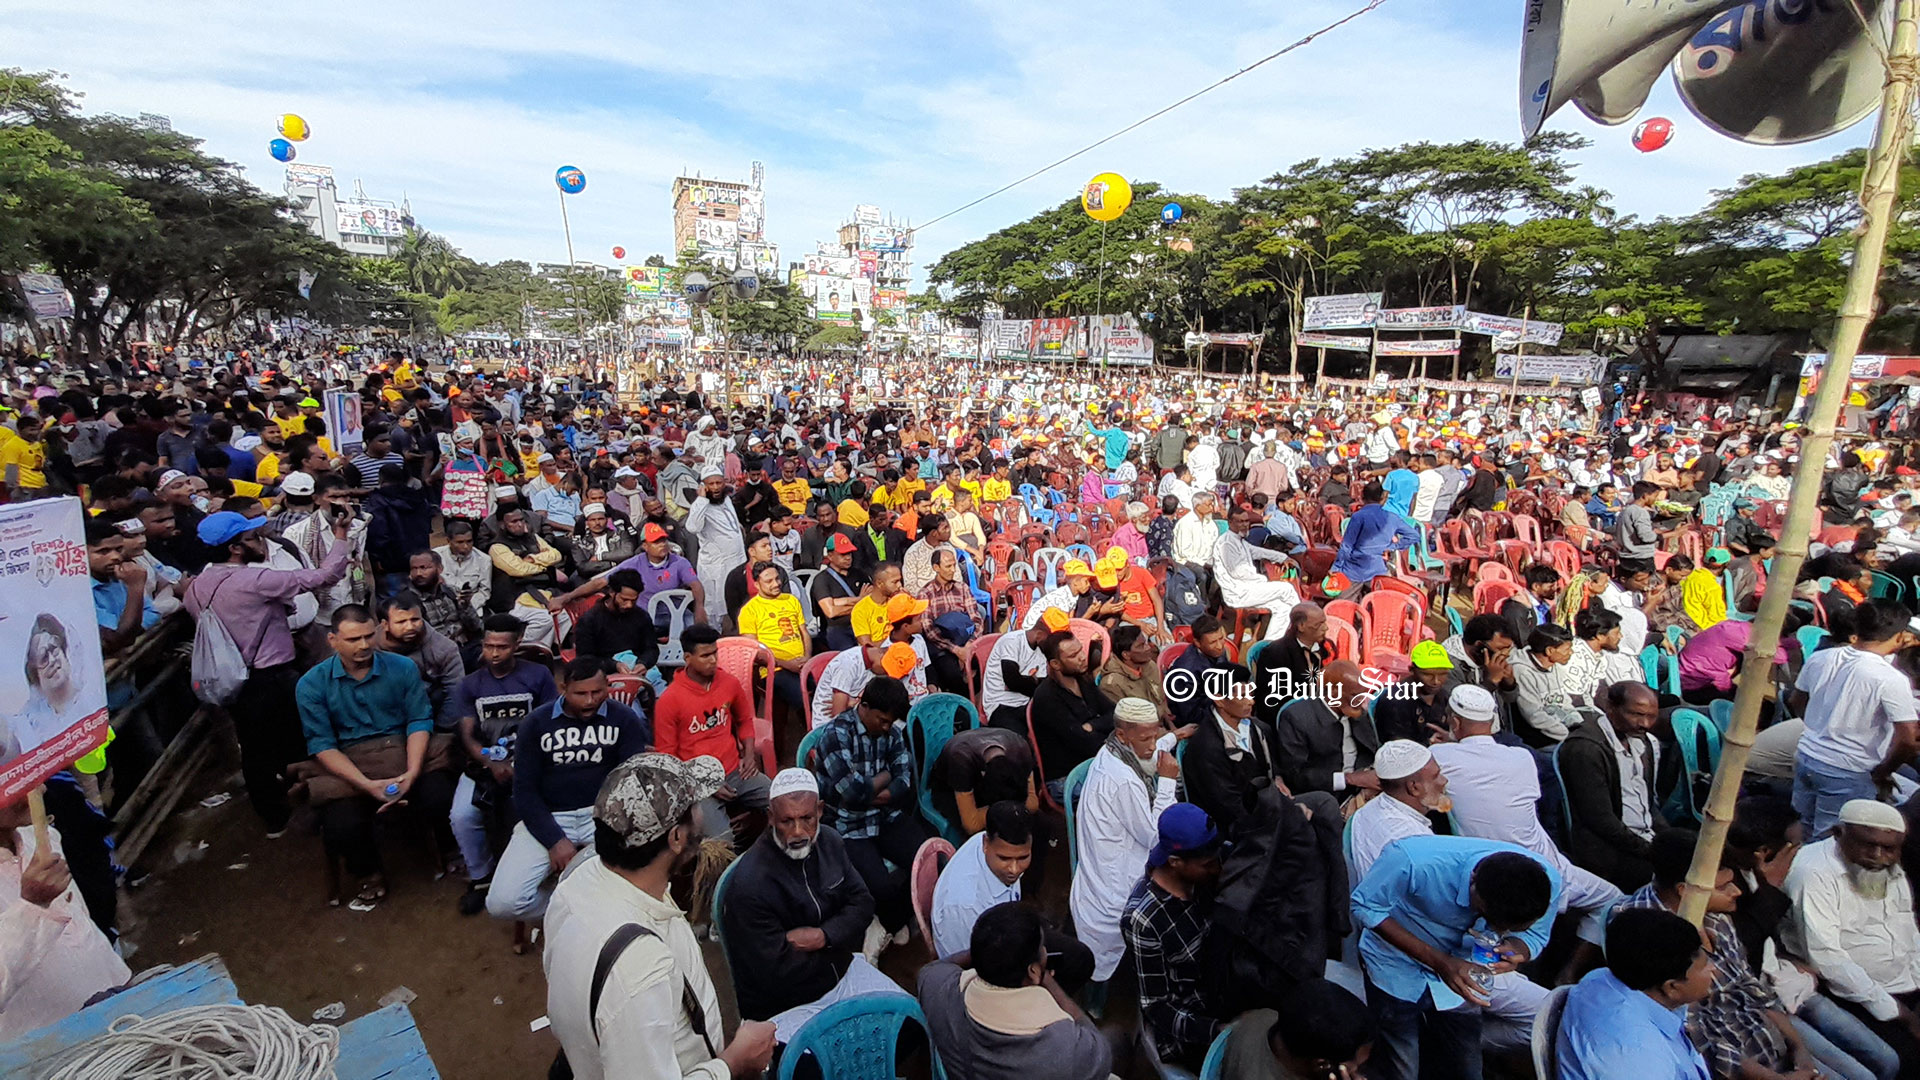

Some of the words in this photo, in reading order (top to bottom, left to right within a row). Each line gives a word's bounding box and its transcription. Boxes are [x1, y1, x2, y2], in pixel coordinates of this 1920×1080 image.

[68, 563, 88, 577] চাই
[540, 725, 619, 752] GSRAW
[552, 747, 603, 765] 5204
